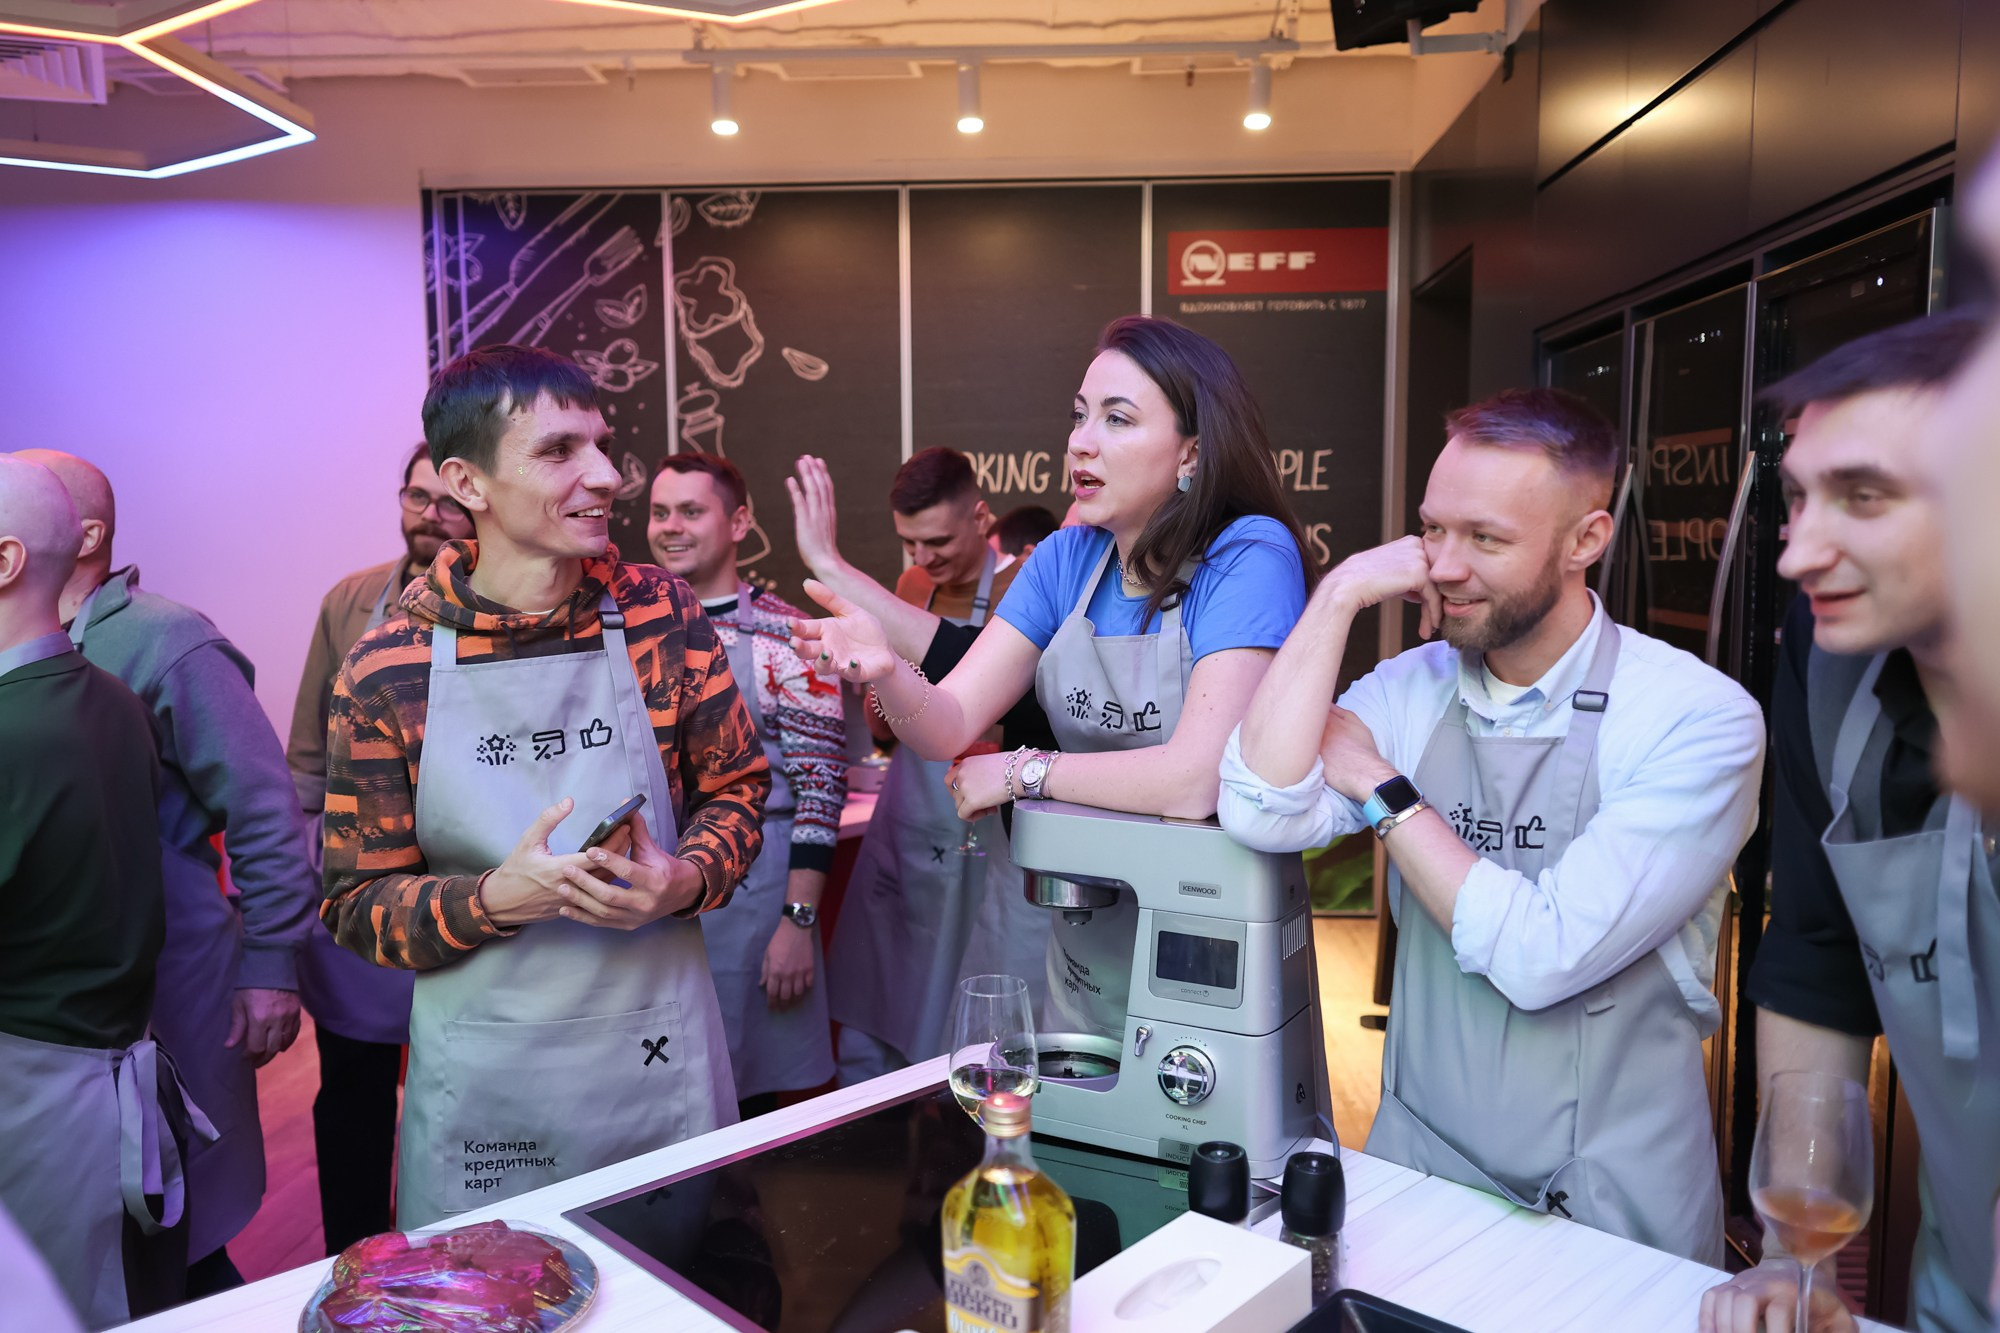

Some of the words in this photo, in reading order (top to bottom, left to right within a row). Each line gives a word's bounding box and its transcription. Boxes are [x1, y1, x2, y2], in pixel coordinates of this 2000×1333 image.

[1183, 246, 1316, 278] NEFF
[1182, 885, 1217, 896] KENWOOD
[1165, 1113, 1191, 1123] COOKING
[1192, 1118, 1207, 1126] CHEF
[463, 1140, 537, 1154] Команда
[464, 1157, 556, 1176] кредитных
[464, 1177, 502, 1193] карт
